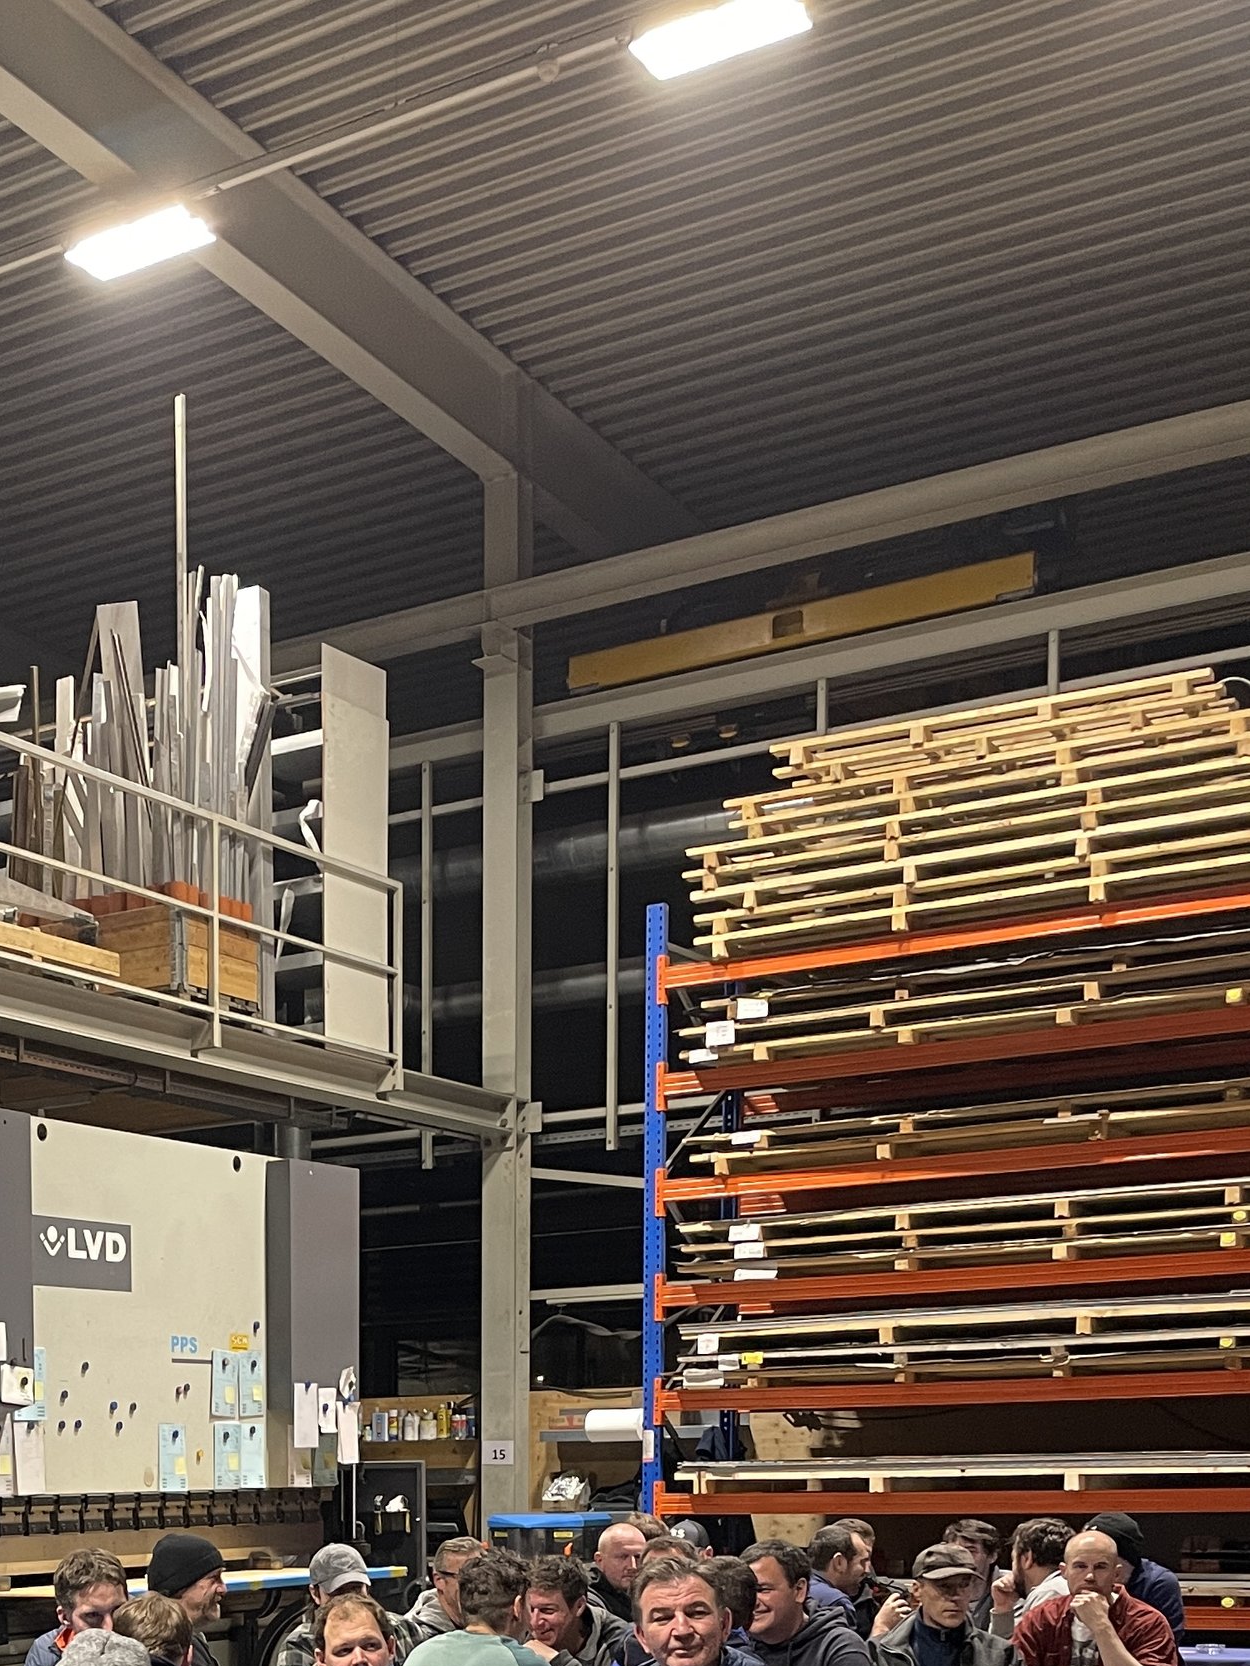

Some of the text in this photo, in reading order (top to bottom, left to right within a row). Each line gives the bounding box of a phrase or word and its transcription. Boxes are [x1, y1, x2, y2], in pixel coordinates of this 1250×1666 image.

[67, 1227, 127, 1262] LVD
[171, 1335, 198, 1353] PPS
[492, 1449, 506, 1460] 15
